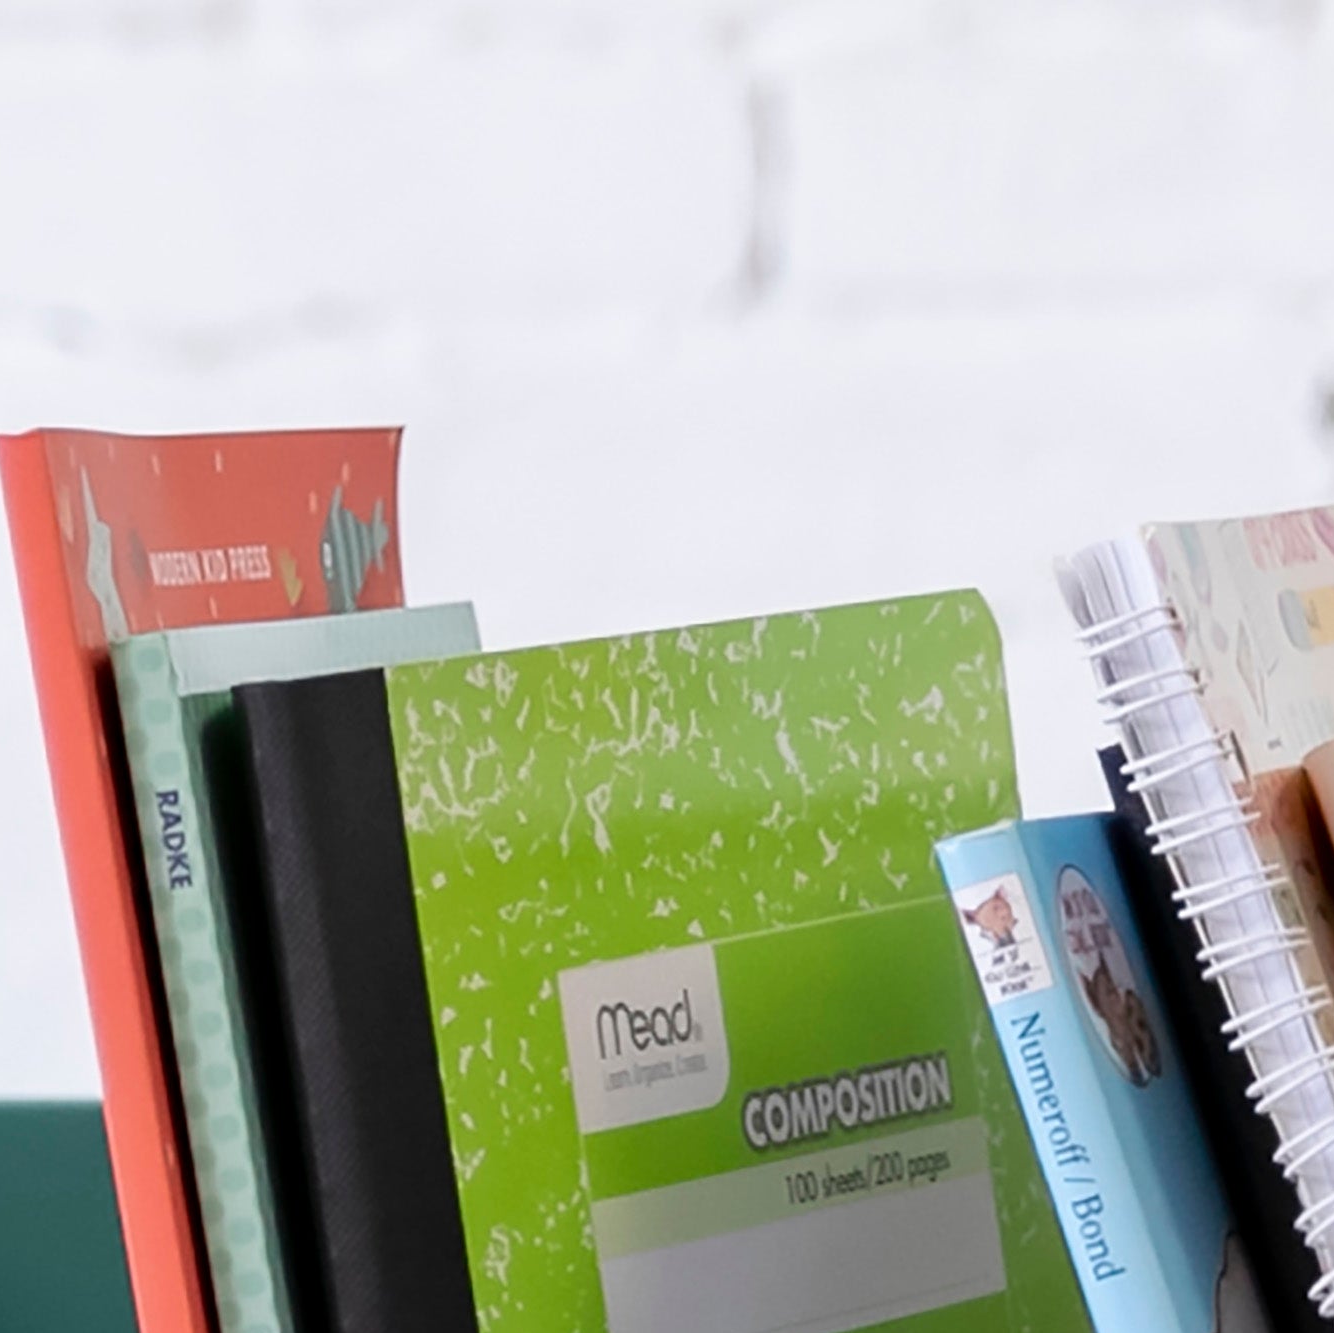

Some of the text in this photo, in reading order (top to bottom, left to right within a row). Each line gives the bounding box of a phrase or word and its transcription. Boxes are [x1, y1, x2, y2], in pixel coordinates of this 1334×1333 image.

[229, 543, 272, 581] PRESS
[155, 789, 193, 891] RADKE
[743, 1055, 953, 1150] COMPOSITION
[1010, 1009, 1091, 1169] Numeroff
[1071, 1193, 1127, 1284] Bond
[784, 1169, 817, 1204] 100
[907, 1150, 952, 1188] pages
